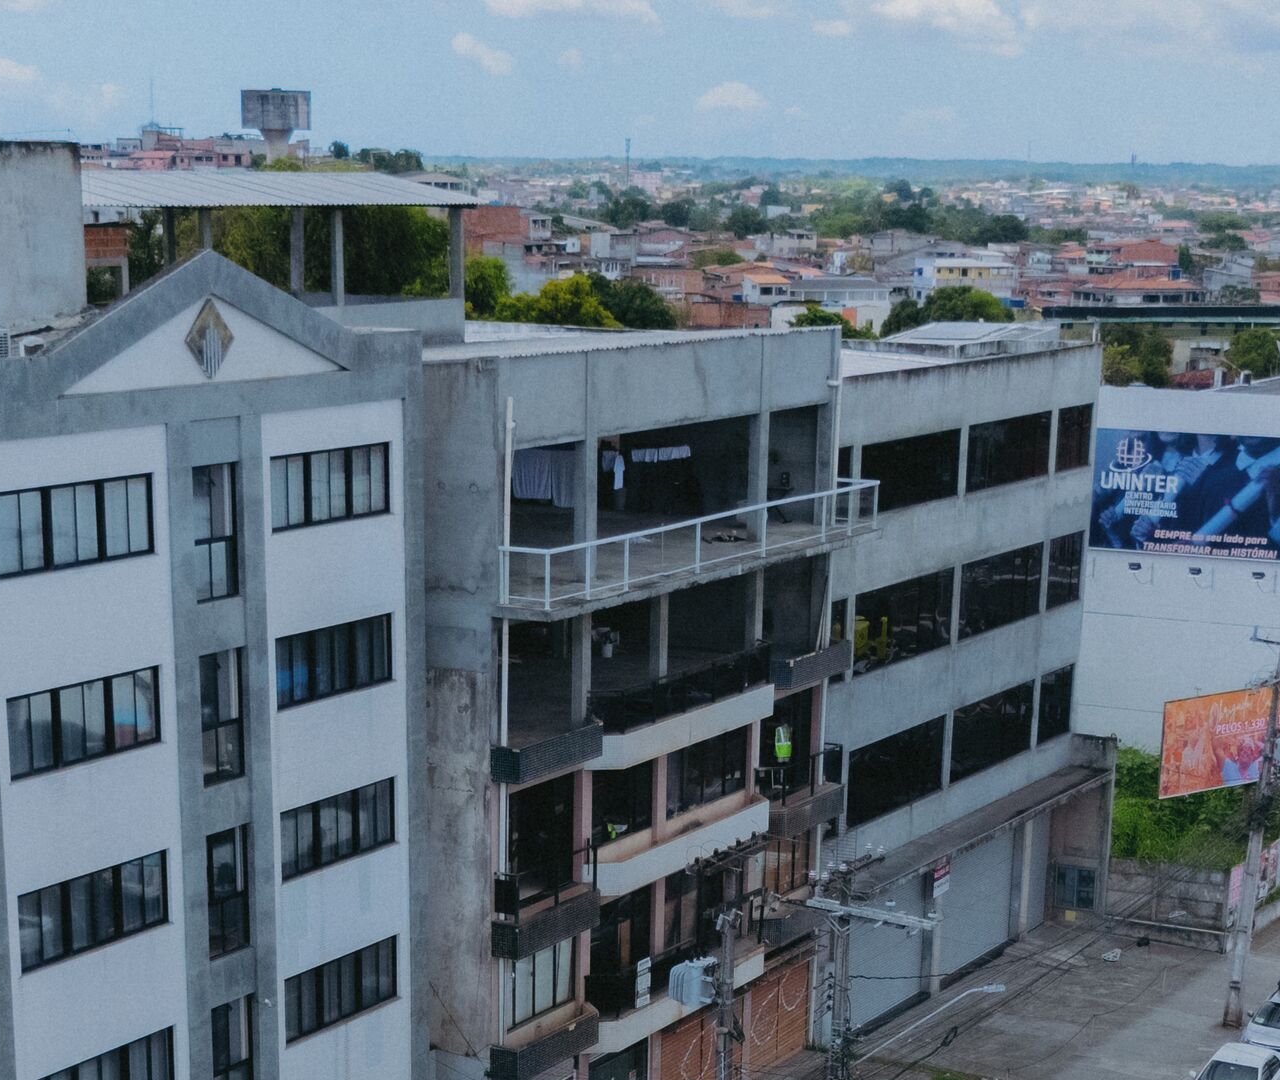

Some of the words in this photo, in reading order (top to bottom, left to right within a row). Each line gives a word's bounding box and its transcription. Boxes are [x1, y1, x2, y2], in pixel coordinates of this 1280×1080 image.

[1100, 471, 1179, 493] UNINTER
[1125, 491, 1153, 501] CENTRO
[1124, 498, 1177, 510] UNIVERSITÁRIO
[1124, 506, 1178, 518] INTERNACIONAL
[1154, 529, 1191, 541] SEMPRE
[1206, 534, 1222, 542] seu
[1224, 533, 1243, 543] lado
[1245, 537, 1268, 546] para
[1143, 541, 1210, 556] TRANSFORMAR
[1231, 546, 1278, 560] HISTÓRIA!
[1215, 723, 1242, 735] PELOS
